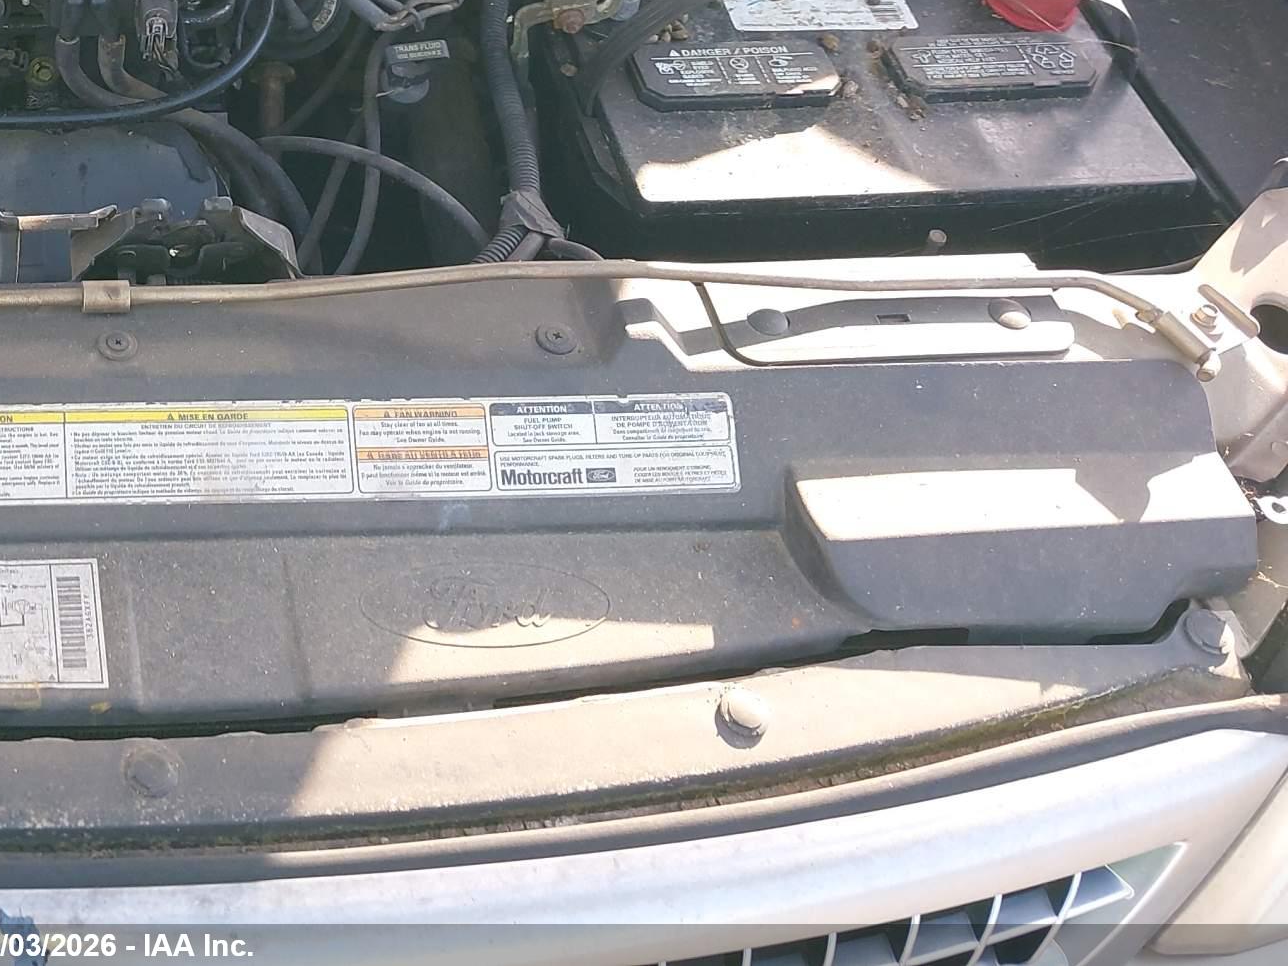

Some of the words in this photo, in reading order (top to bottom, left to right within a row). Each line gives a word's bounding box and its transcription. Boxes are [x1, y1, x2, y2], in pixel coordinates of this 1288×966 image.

[394, 44, 418, 52] TRANS
[420, 42, 440, 50] FLUID
[681, 47, 728, 57] DANGER
[745, 45, 788, 55] POISON
[217, 412, 248, 420] GARDE
[501, 469, 583, 485] Motorcraft
